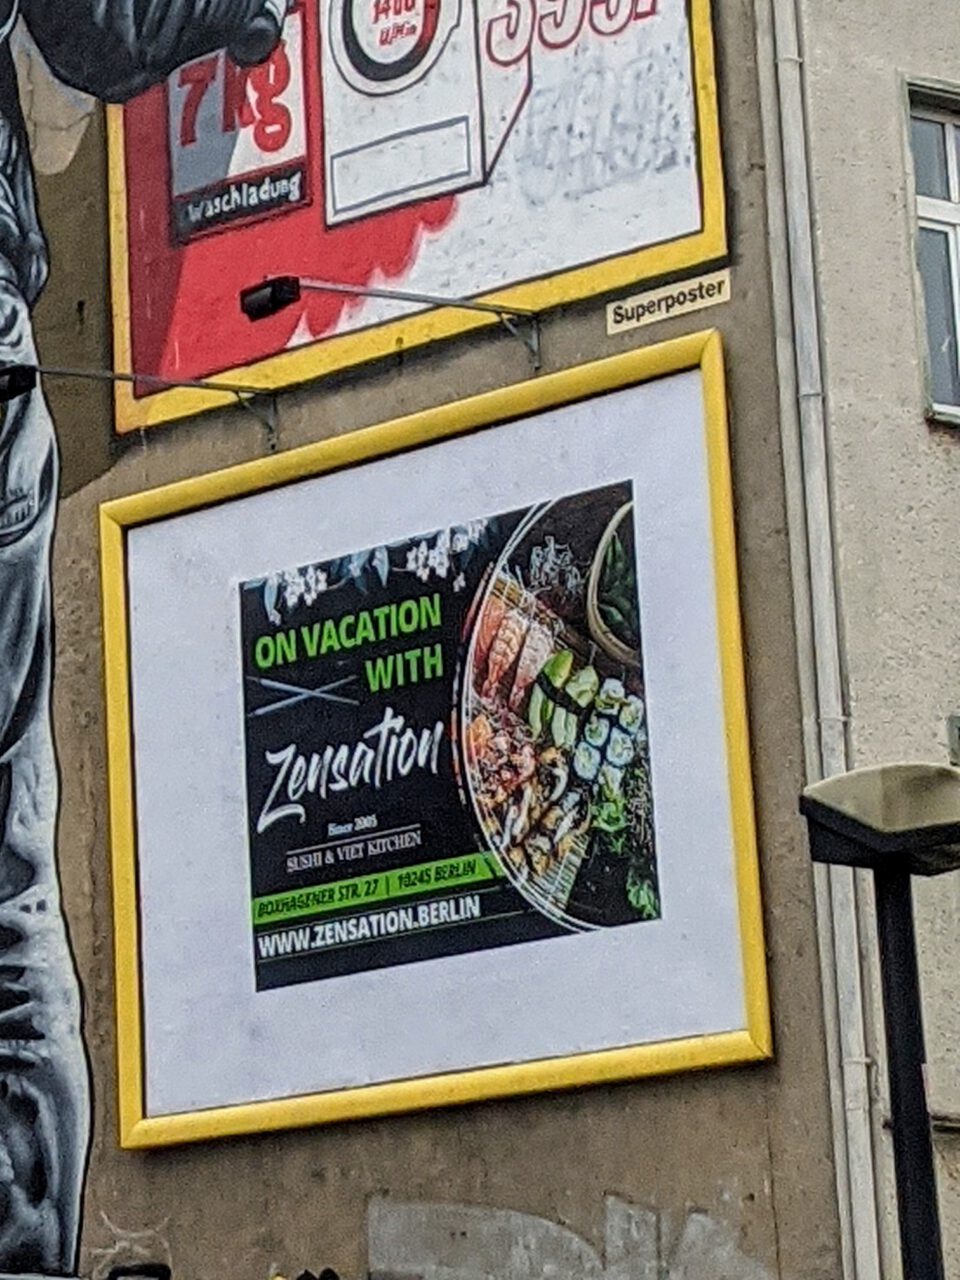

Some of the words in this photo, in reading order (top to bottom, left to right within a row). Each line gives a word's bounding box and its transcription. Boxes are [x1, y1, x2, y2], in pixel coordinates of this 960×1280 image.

[613, 280, 725, 324] Superposter
[255, 628, 298, 669] ON
[301, 593, 441, 657] VACATION
[365, 642, 444, 693] WITH
[257, 706, 445, 834] Zensation
[287, 851, 322, 872] SUSHI
[324, 848, 335, 864] &
[337, 843, 365, 862] VIET
[367, 830, 422, 857] KITCHEN
[434, 858, 478, 882] BERLIN
[257, 895, 481, 958] WWW.ZENSATION.BERLIN
